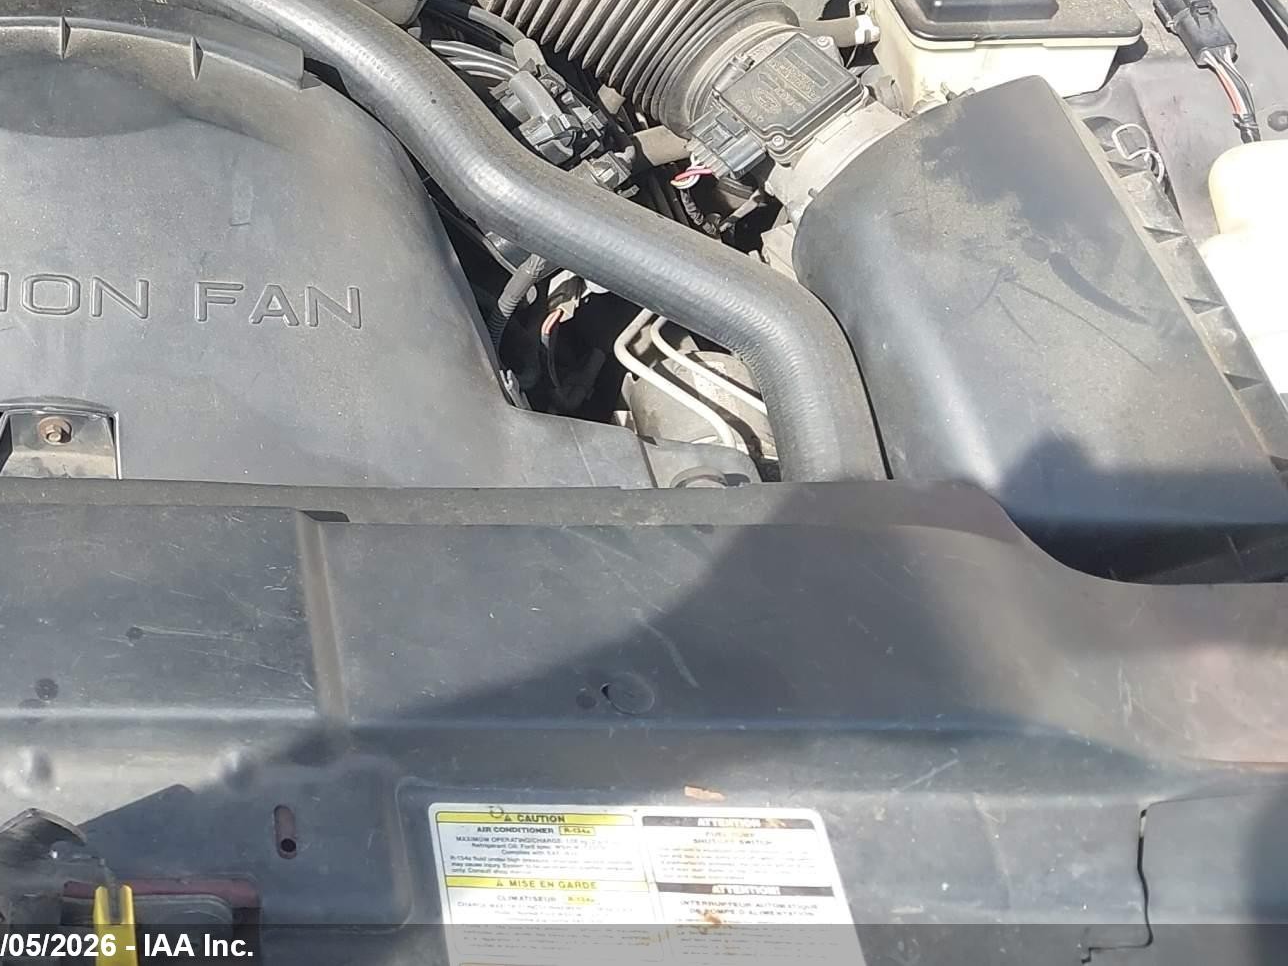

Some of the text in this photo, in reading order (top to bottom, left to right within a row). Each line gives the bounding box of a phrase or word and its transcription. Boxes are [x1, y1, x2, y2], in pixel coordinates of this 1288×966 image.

[194, 280, 362, 330] FAN
[517, 815, 566, 823] CAUTION
[493, 826, 554, 834] CONDITIONER
[508, 880, 535, 888] MISE
[558, 881, 598, 889] GARDE
